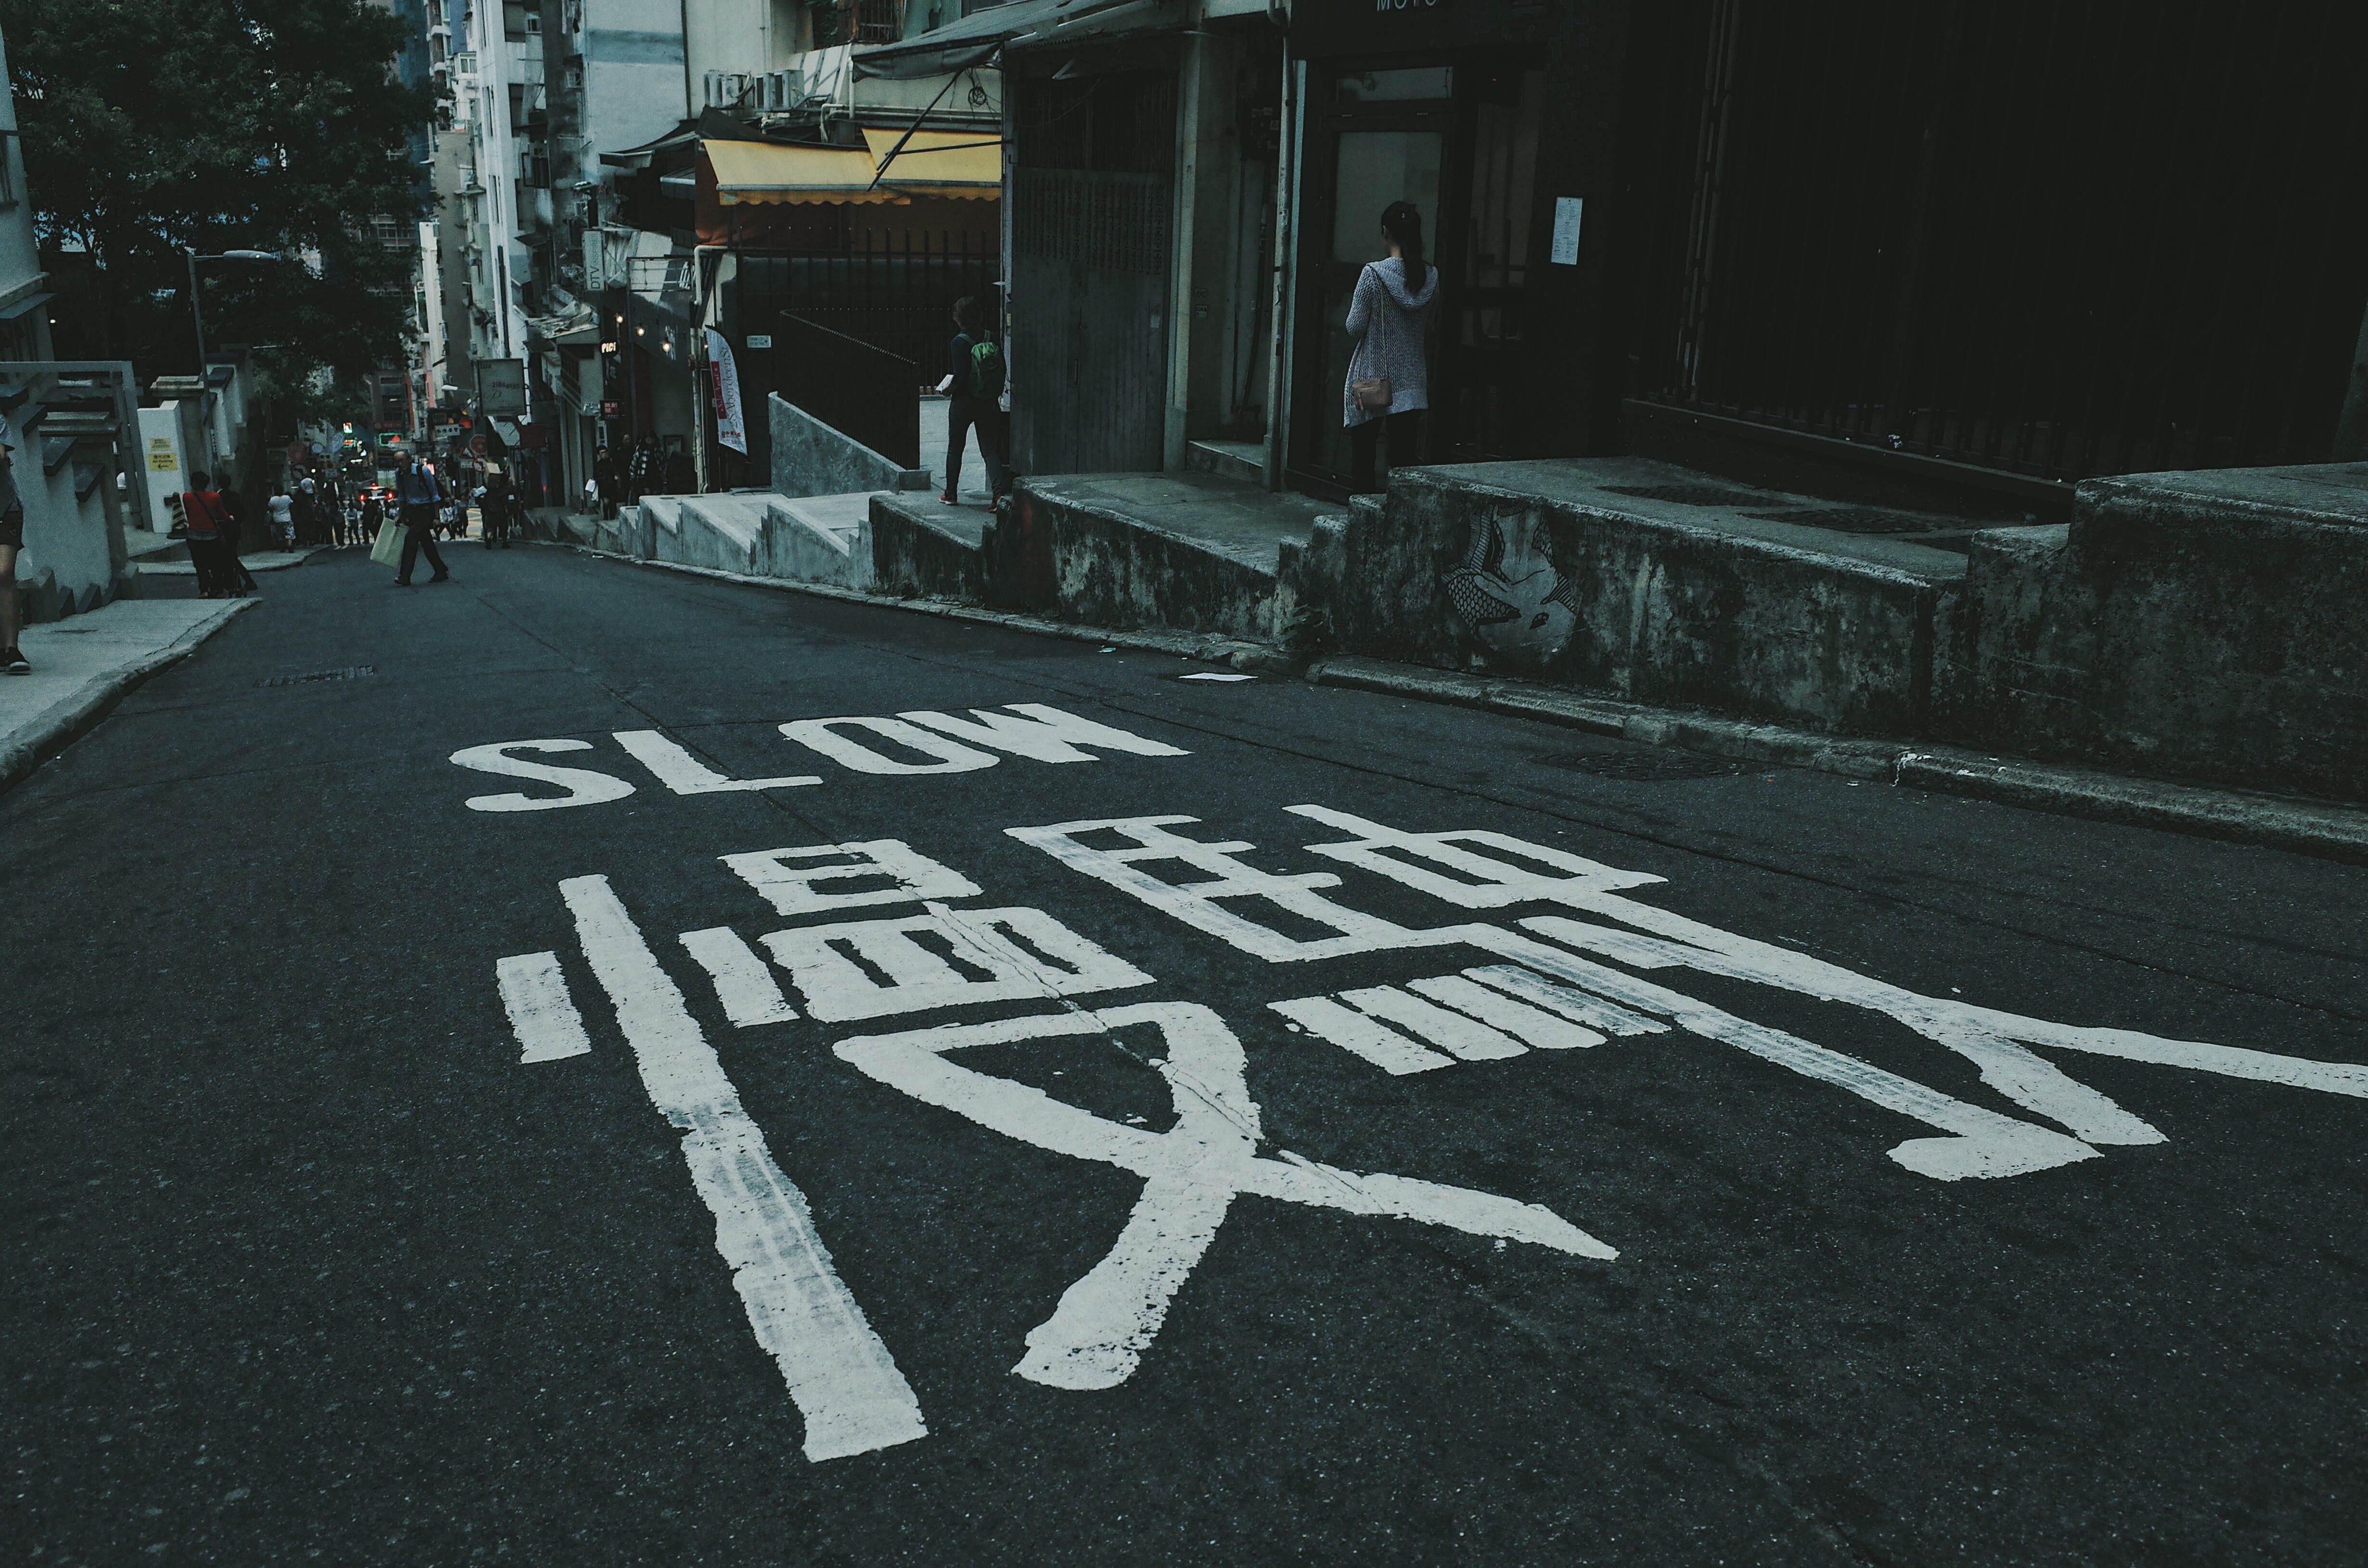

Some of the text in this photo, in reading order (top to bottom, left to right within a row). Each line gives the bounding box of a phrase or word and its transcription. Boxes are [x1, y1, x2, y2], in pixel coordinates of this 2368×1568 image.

[590, 265, 600, 289] DTV
[448, 703, 1195, 812] SLOW
[495, 804, 2368, 1463] 慢駛
